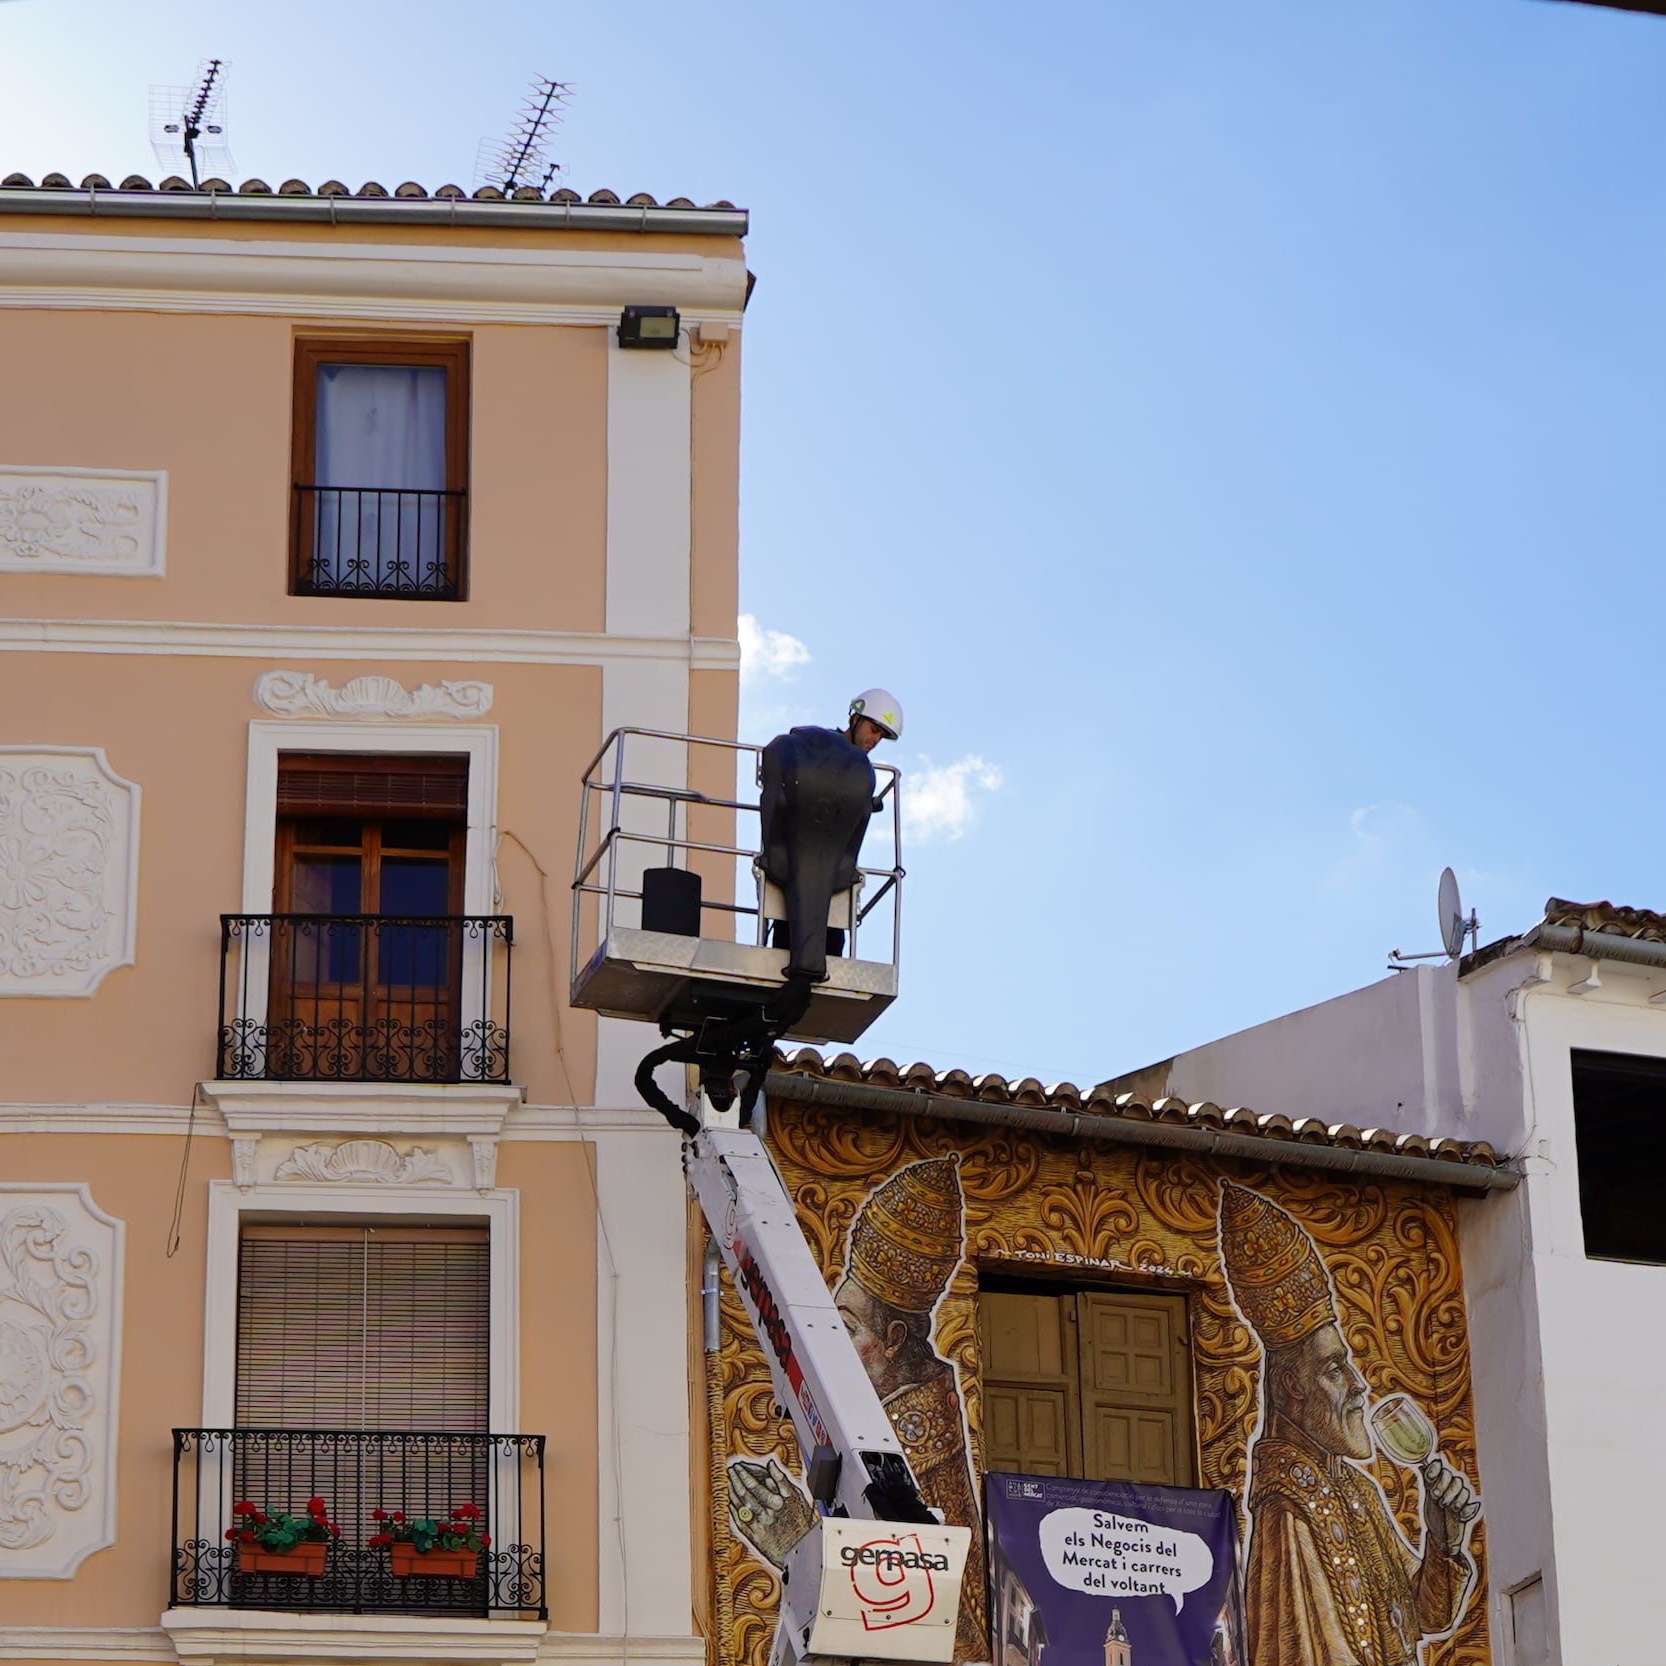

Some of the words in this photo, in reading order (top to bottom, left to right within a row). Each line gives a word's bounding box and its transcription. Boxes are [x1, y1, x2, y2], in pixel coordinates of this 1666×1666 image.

[1015, 1250, 1051, 1260] TONI
[1054, 1252, 1133, 1270] ESPINAR
[1138, 1263, 1174, 1275] 2024
[1093, 1513, 1149, 1533] Salvem
[1065, 1532, 1085, 1547] els
[1091, 1534, 1152, 1556] Negocis
[1156, 1541, 1177, 1557] del
[840, 1545, 949, 1572] gerpasa
[1062, 1552, 1118, 1571] Mercat
[1122, 1557, 1126, 1570] i
[1131, 1562, 1181, 1578] carrers
[1083, 1573, 1106, 1589] del
[1110, 1579, 1165, 1595] voltant
